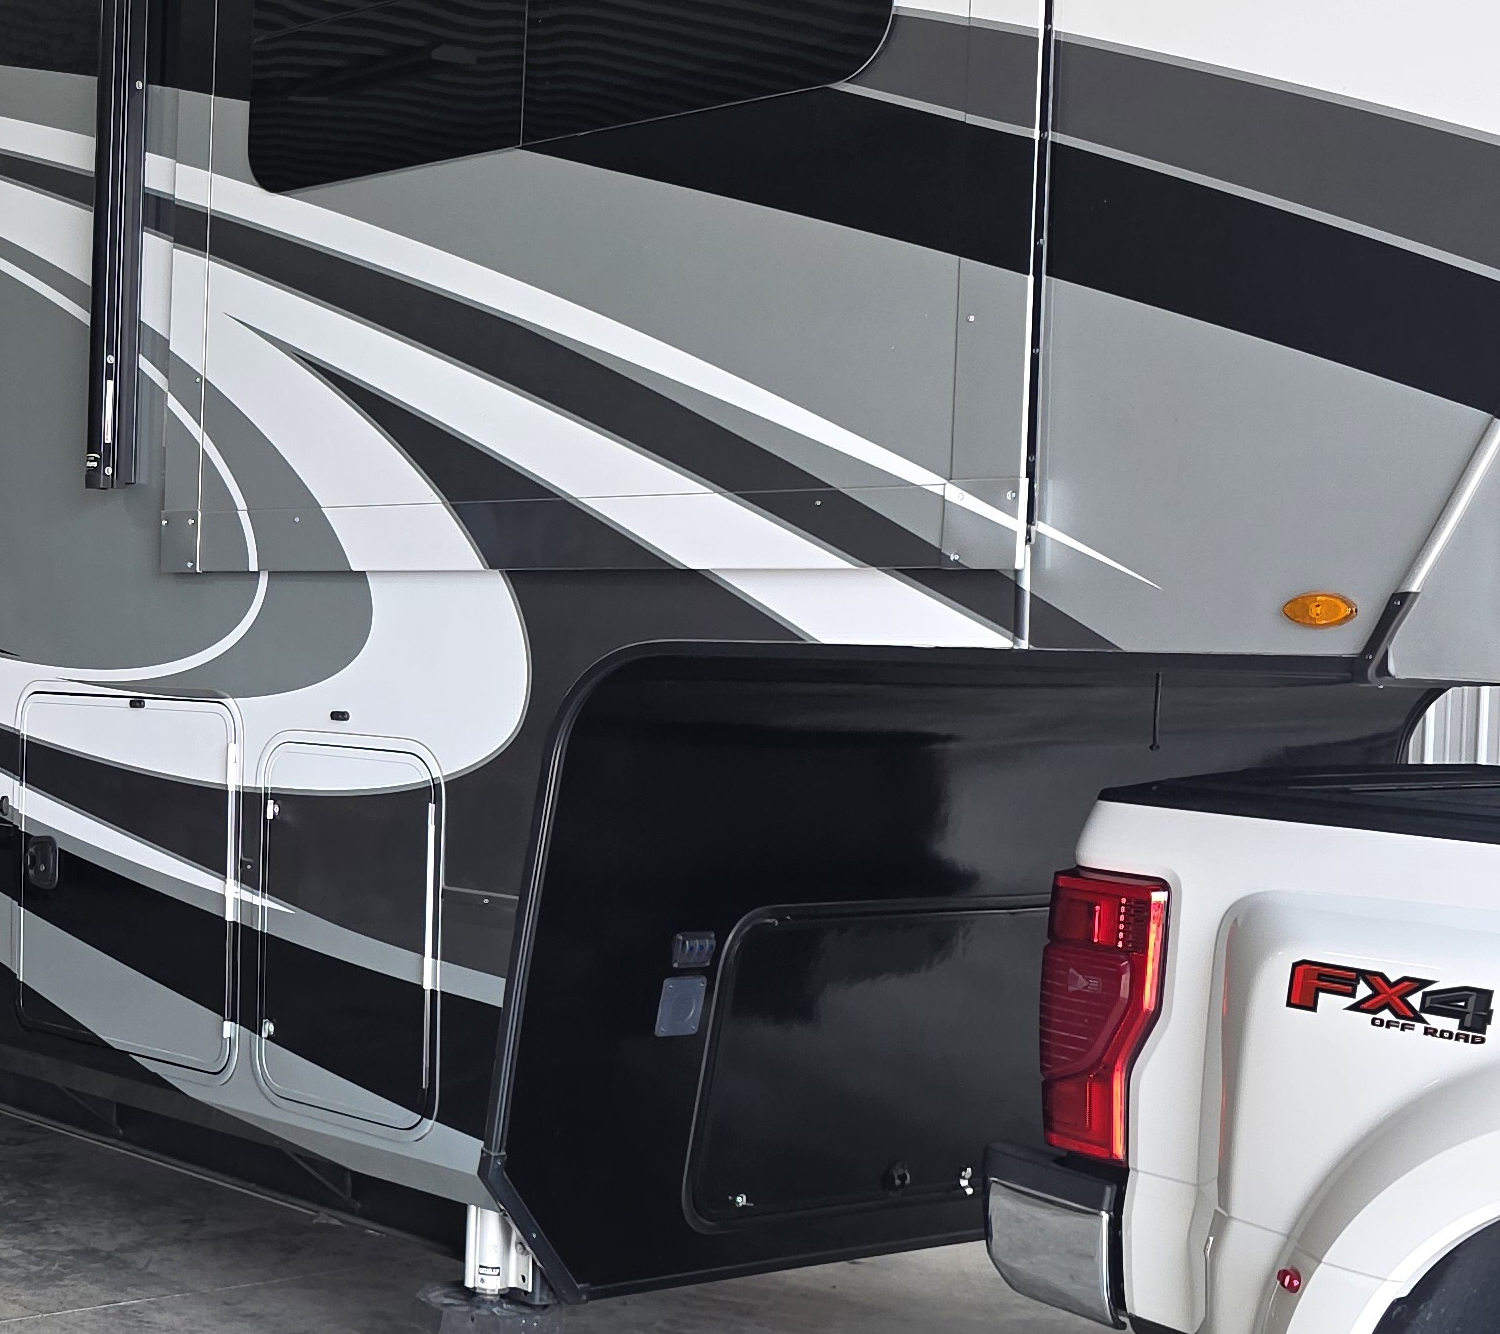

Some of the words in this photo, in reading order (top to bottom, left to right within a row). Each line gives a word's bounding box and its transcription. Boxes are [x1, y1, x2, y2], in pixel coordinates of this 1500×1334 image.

[1286, 959, 1495, 1035] FX4
[1370, 1017, 1416, 1032] OFF
[1423, 1025, 1486, 1045] ROAD
